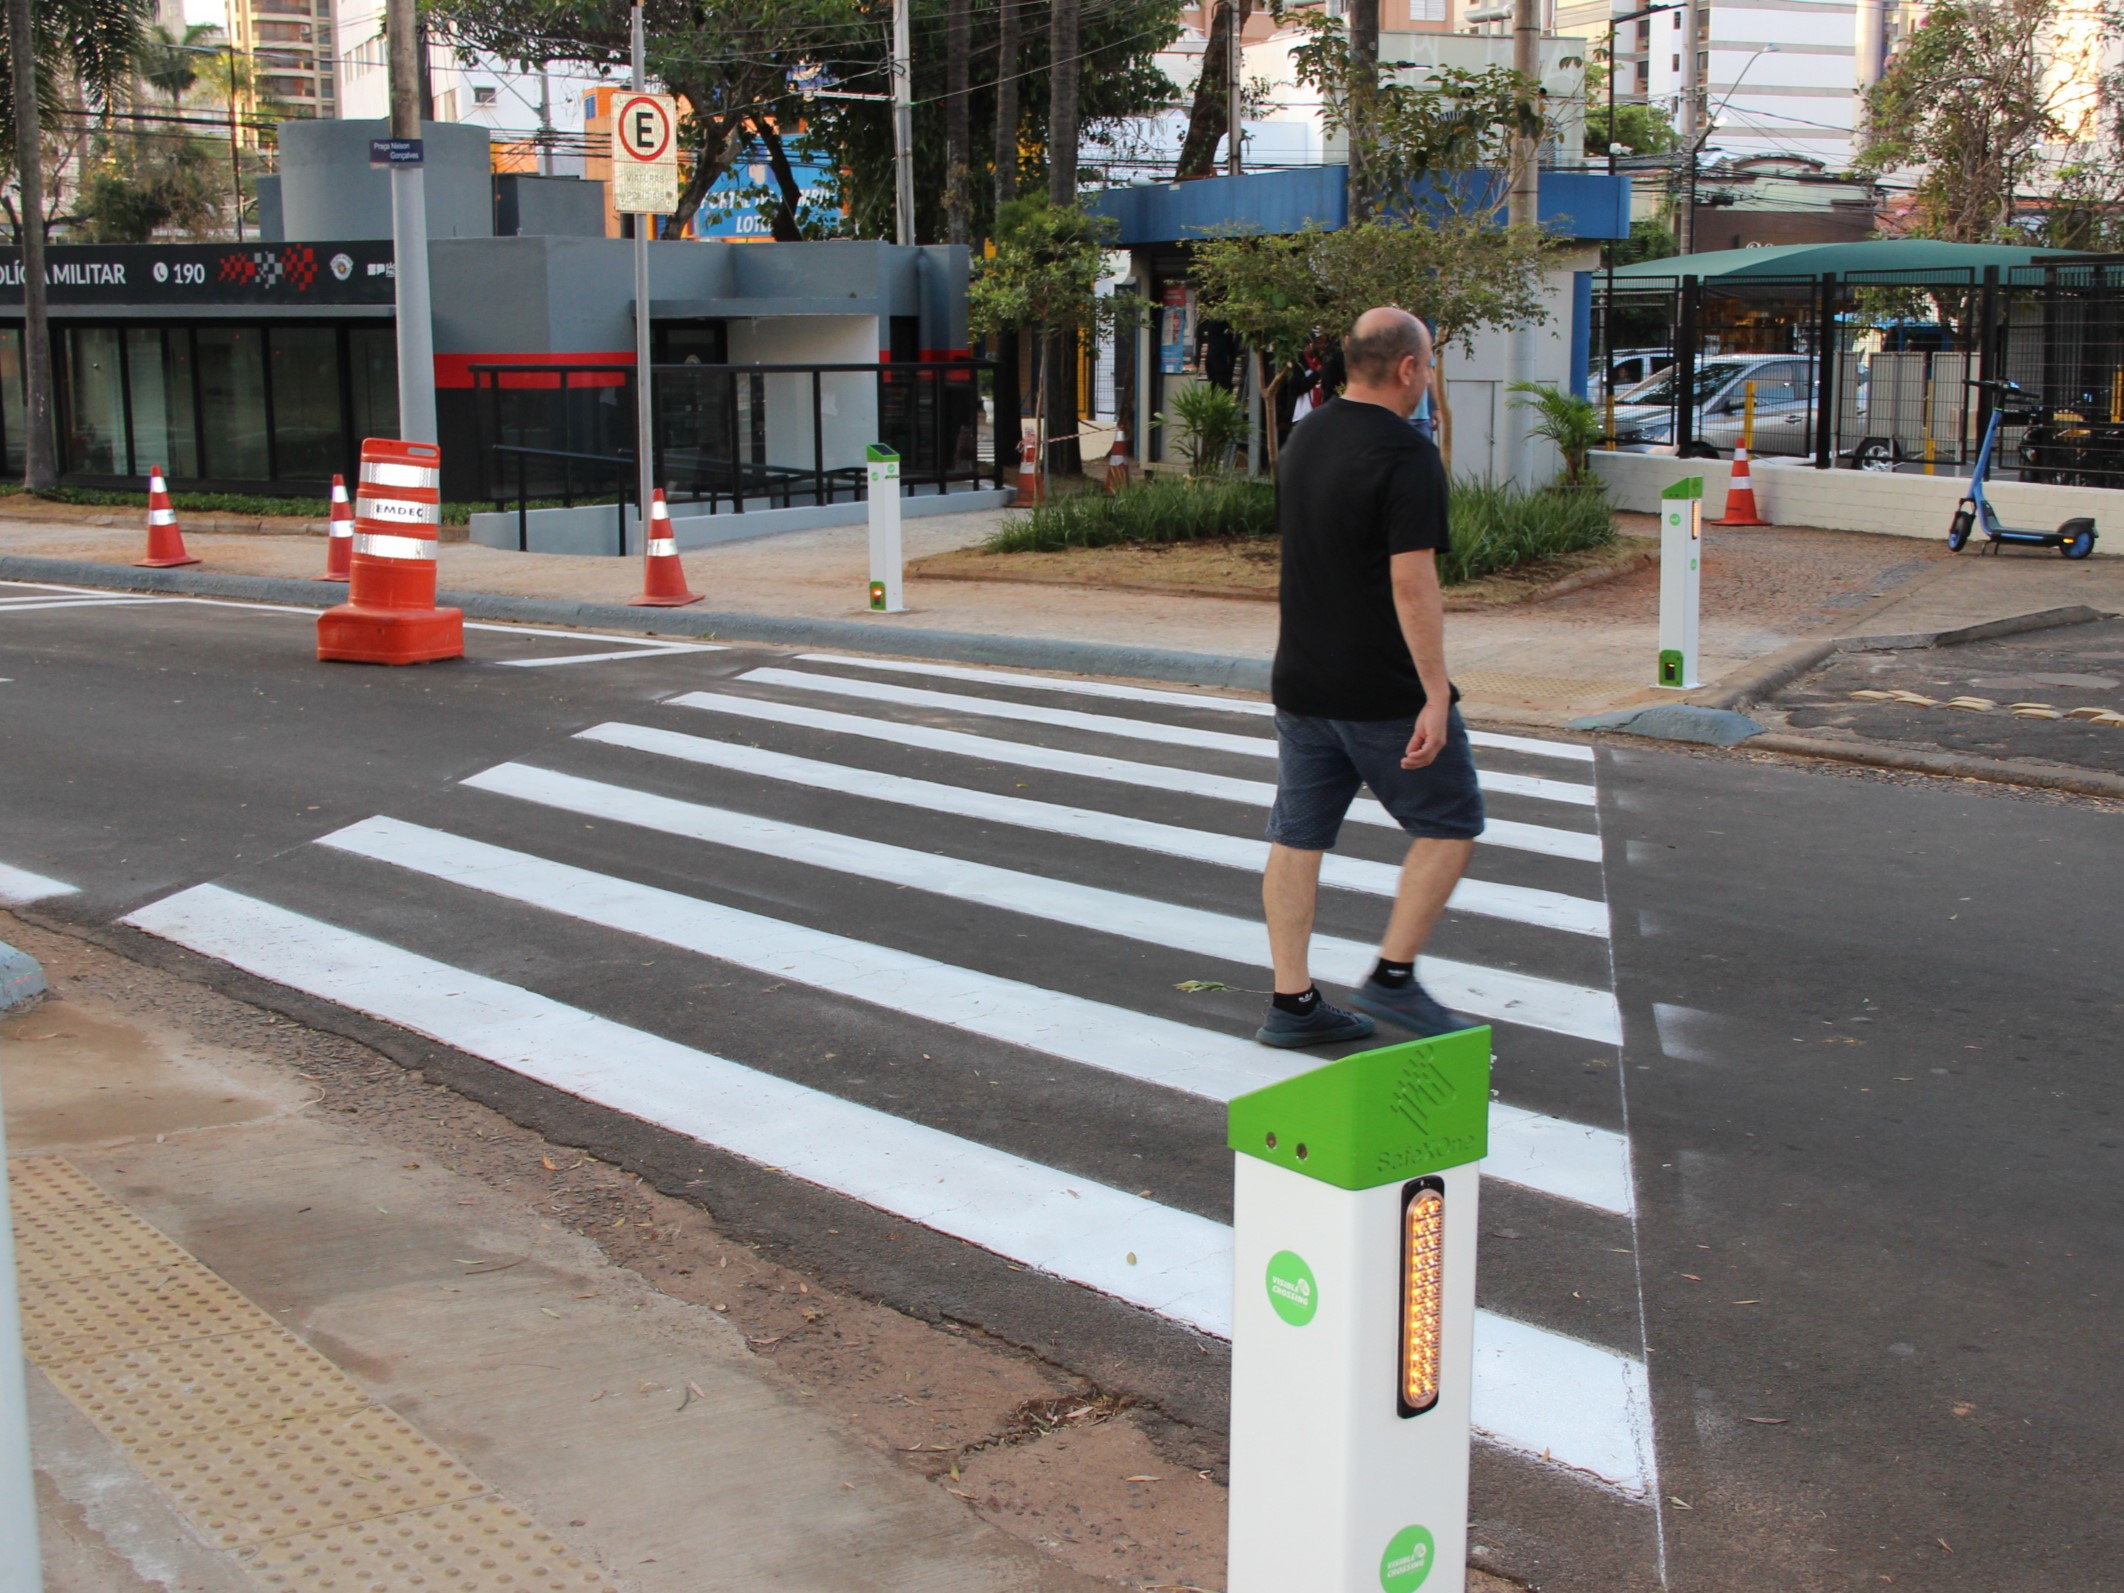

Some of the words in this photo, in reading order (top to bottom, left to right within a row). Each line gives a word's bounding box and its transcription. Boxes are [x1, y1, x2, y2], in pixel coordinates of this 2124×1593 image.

[636, 112, 654, 148] E
[52, 263, 126, 284] MILITAR
[173, 263, 205, 284] 190
[376, 504, 424, 517] EMDEC
[1272, 1285, 1309, 1306] CROSSING
